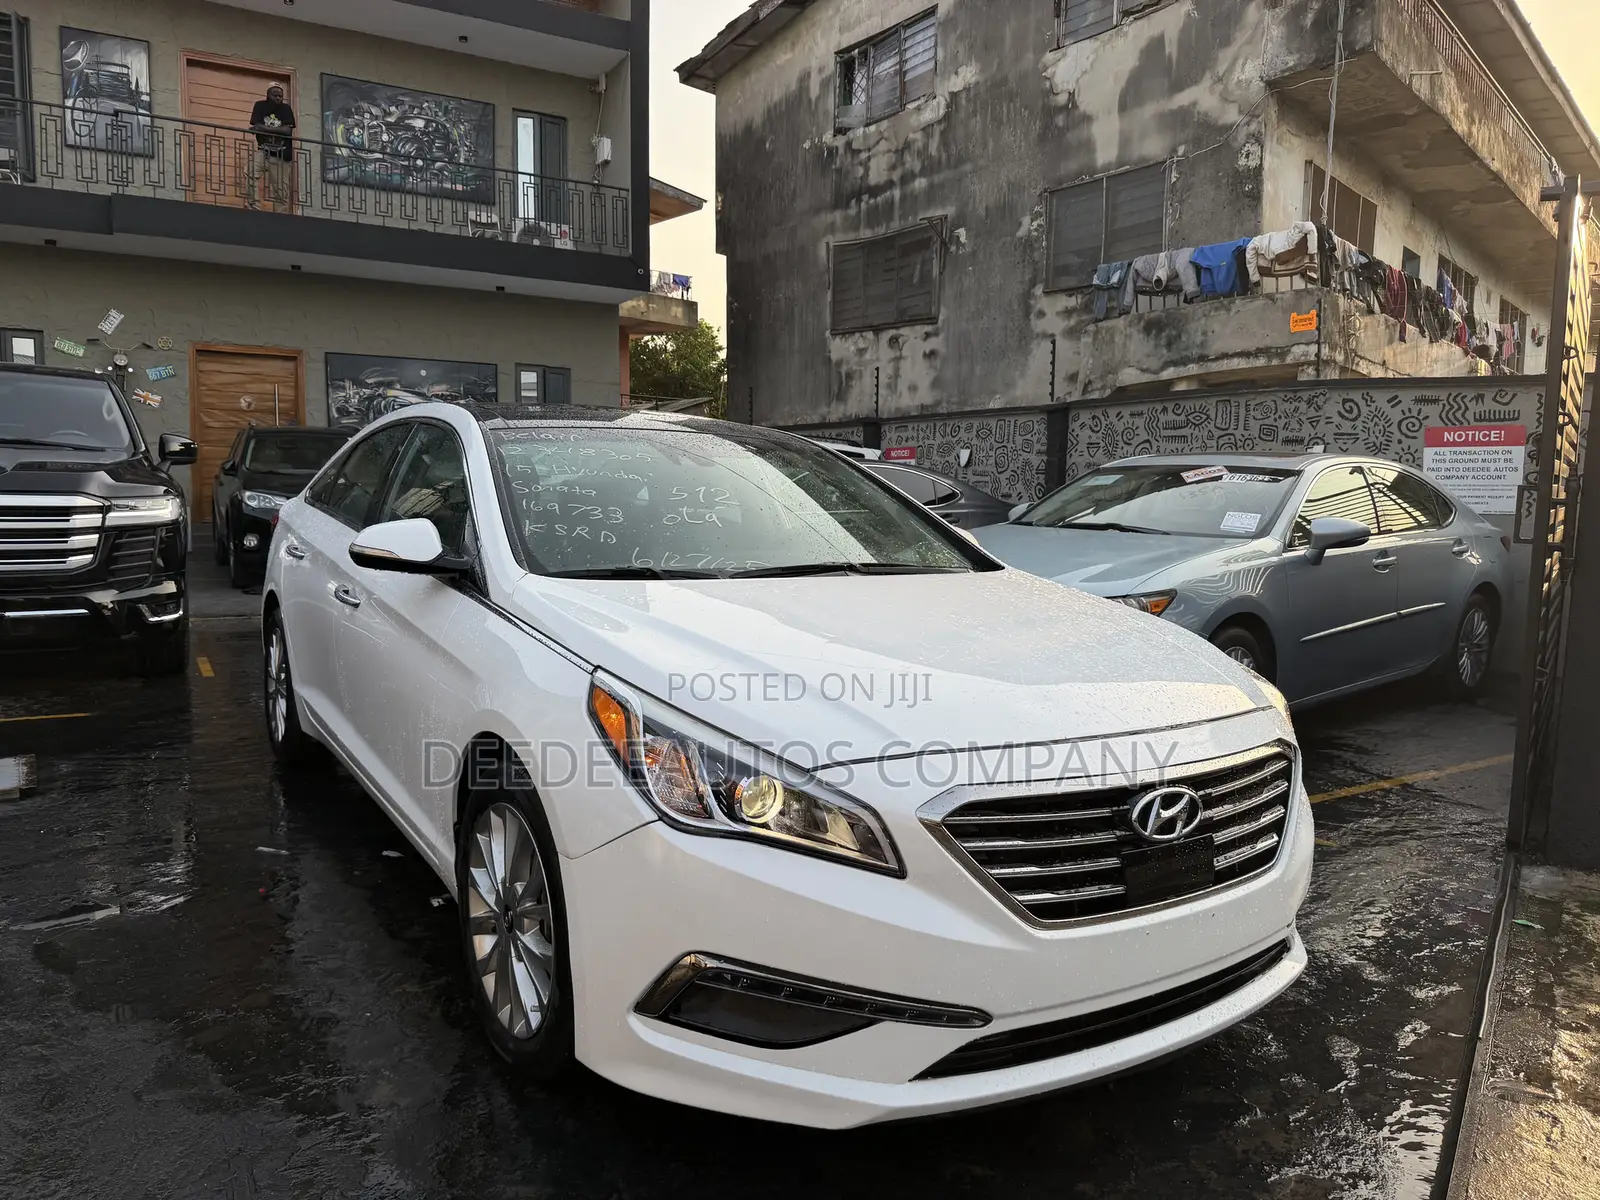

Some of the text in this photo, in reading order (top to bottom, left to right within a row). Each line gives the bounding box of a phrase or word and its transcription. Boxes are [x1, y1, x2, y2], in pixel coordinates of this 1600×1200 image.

[1443, 430, 1505, 442] NOTICE!
[511, 481, 597, 497] Sonata
[668, 486, 741, 506] 512
